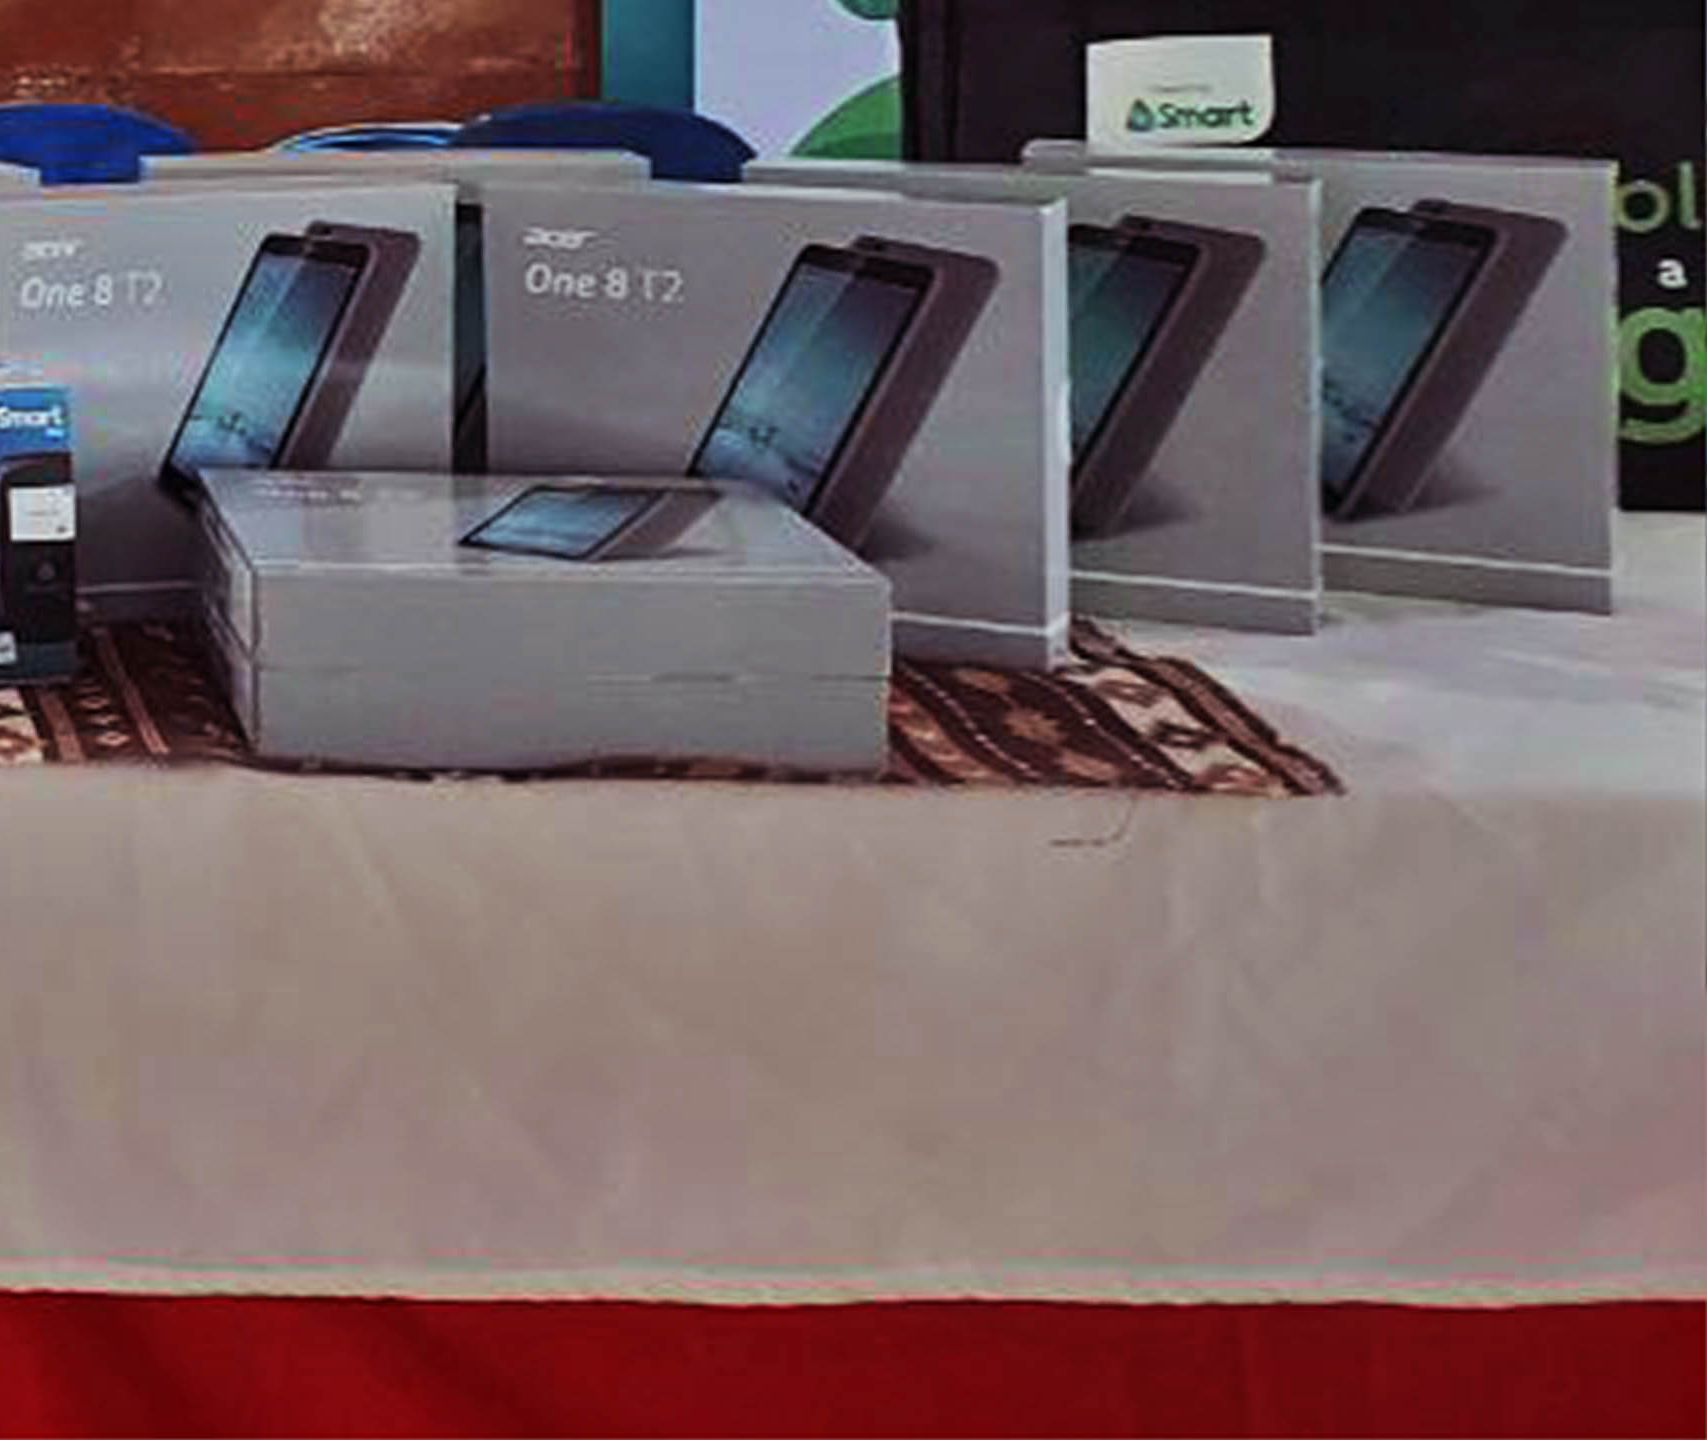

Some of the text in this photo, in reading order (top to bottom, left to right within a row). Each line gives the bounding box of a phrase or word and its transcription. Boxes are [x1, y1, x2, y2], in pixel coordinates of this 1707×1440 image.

[1159, 100, 1254, 128] Smart
[20, 276, 85, 309] One
[93, 273, 114, 306] 8
[525, 262, 686, 304] One 8 T2
